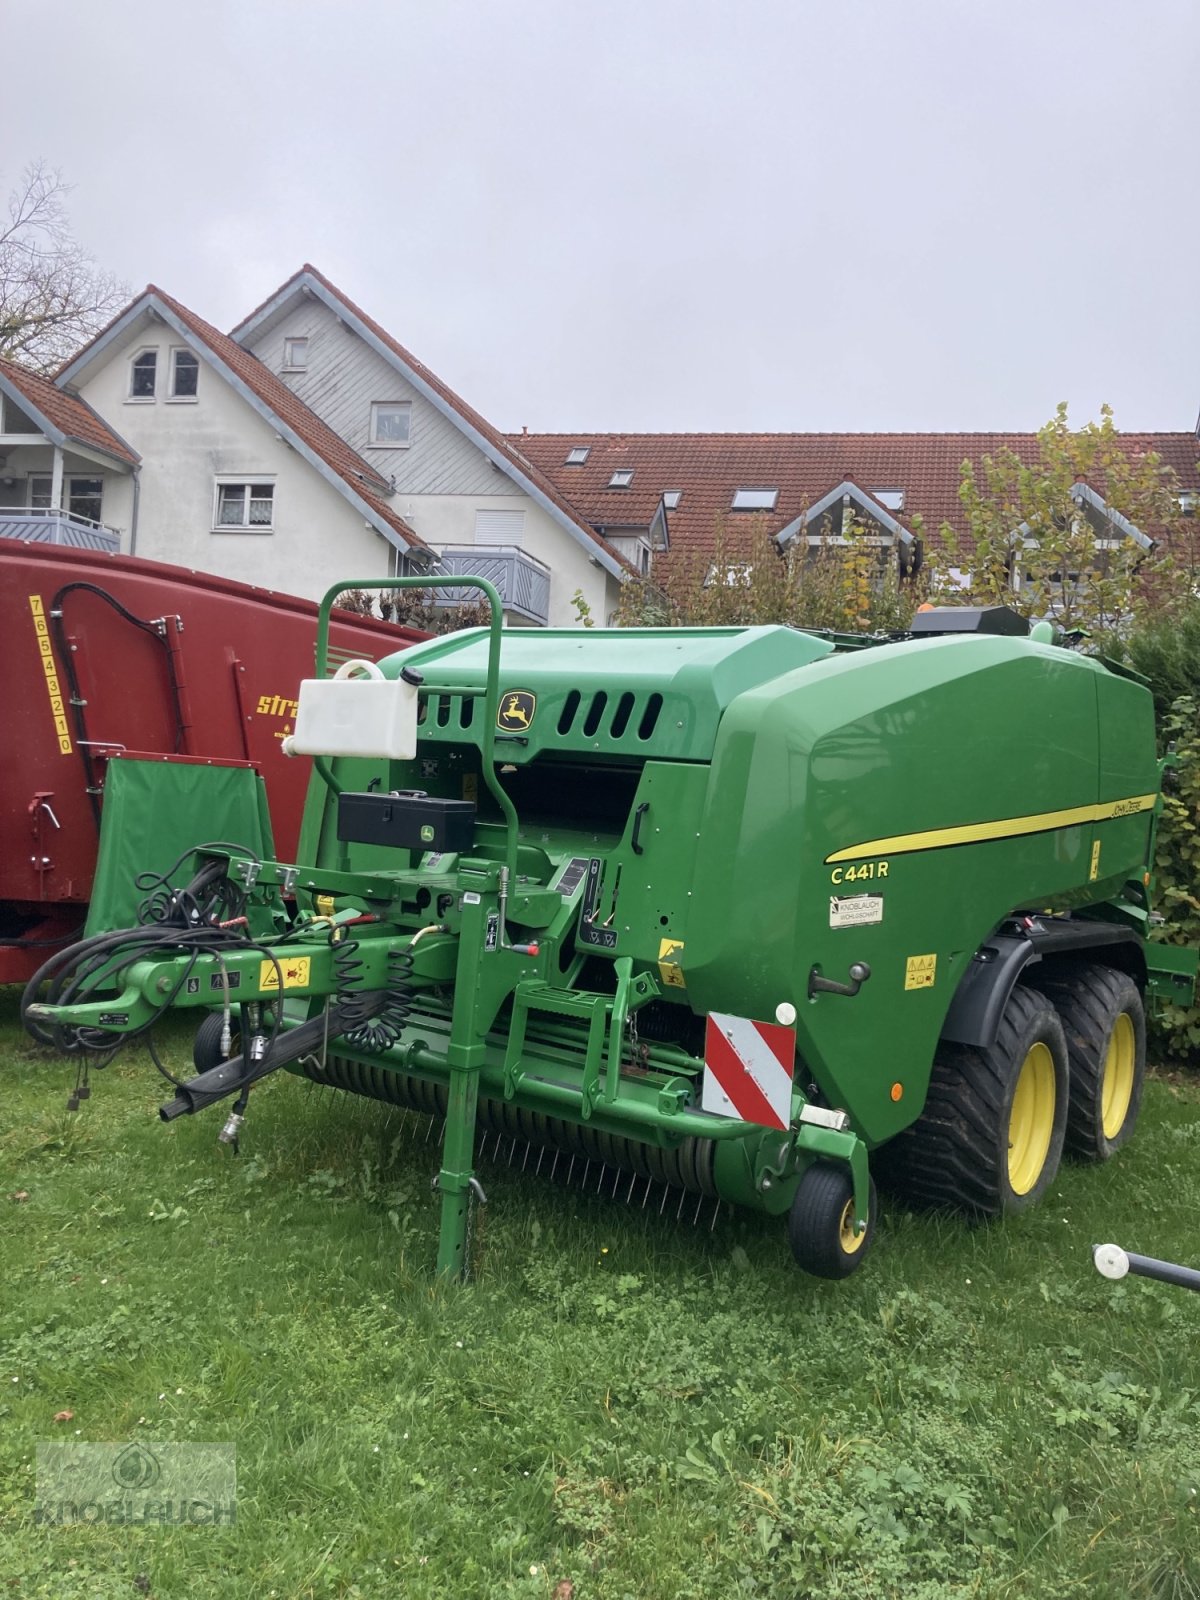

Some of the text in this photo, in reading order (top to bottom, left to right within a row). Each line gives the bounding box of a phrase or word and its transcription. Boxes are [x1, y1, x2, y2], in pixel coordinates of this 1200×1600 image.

[31, 600, 40, 611] 7
[37, 620, 46, 632] 6
[41, 640, 50, 652] 5
[46, 660, 53, 672] 4
[50, 681, 58, 691] 3
[54, 700, 61, 711] 2
[61, 740, 70, 751] 0
[840, 901, 880, 911] KNOBLAUCH
